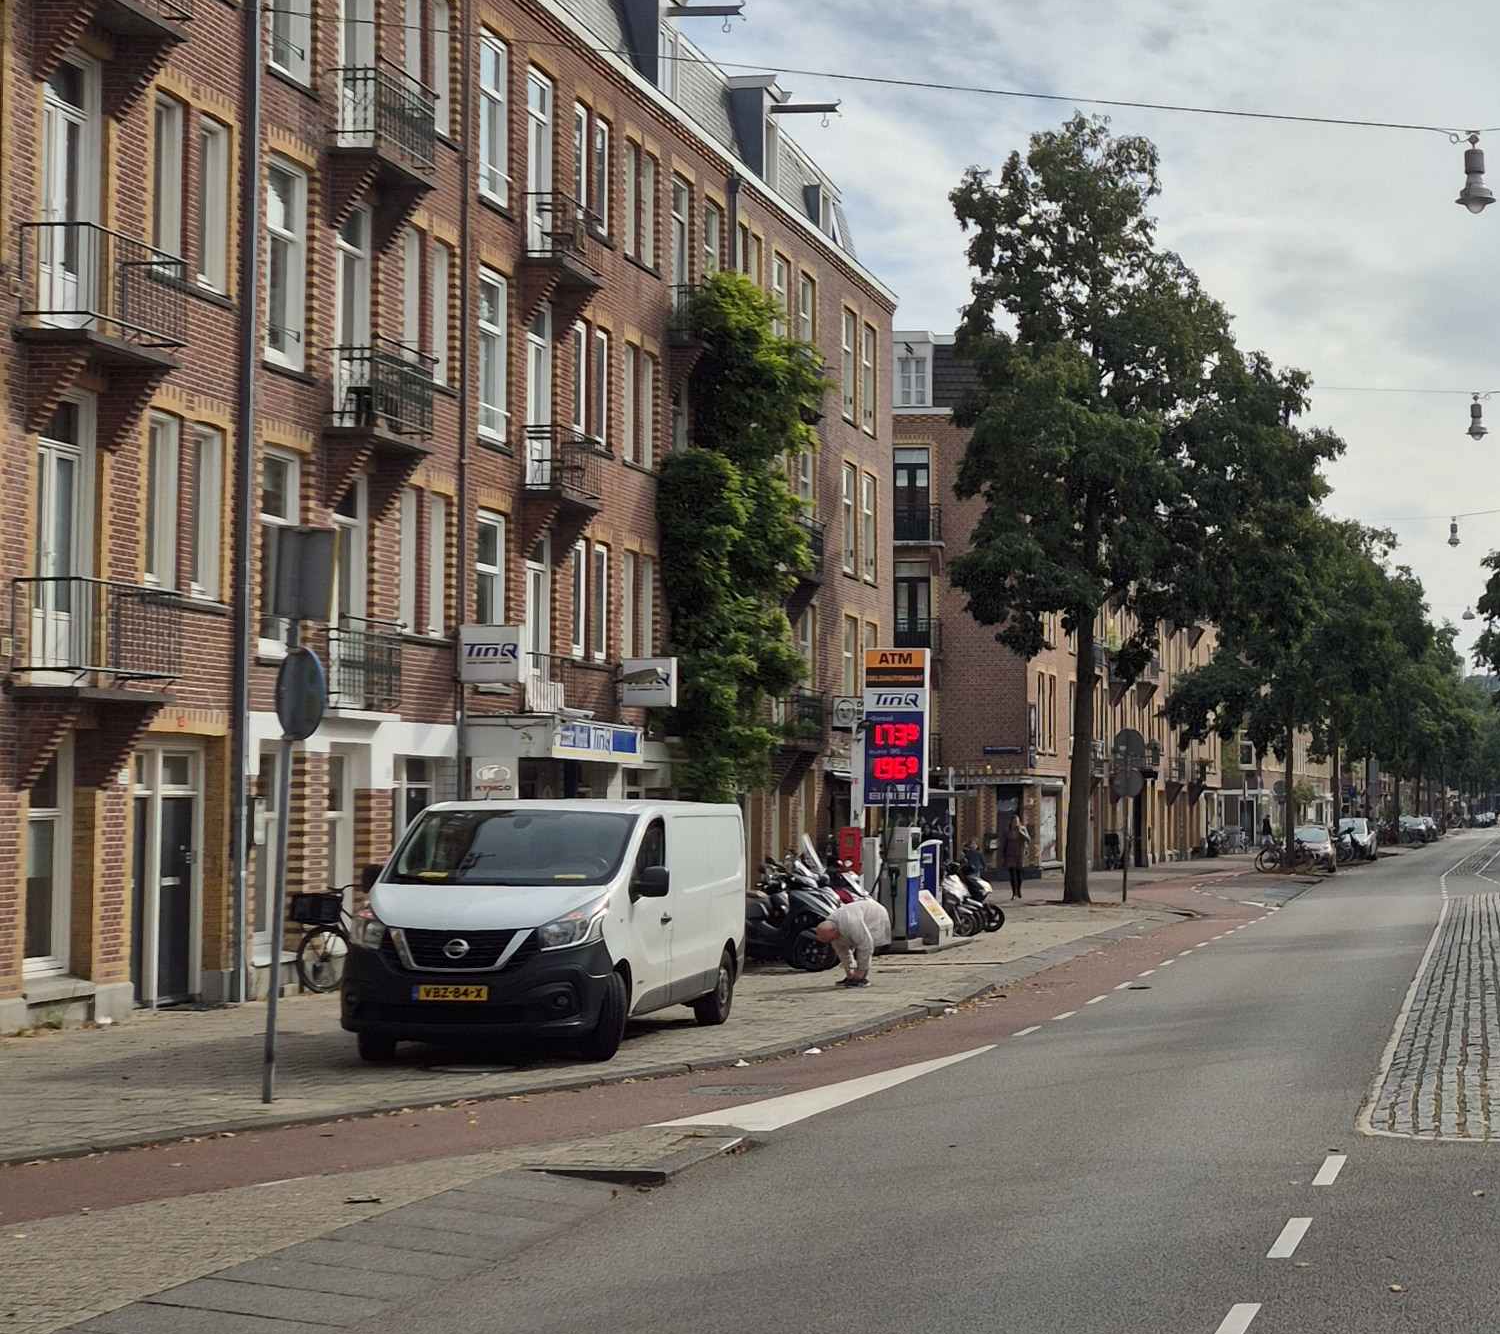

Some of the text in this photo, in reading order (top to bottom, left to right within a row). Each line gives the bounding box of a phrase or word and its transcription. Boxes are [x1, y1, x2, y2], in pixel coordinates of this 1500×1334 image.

[464, 642, 518, 660] TinQ
[878, 652, 912, 665] ATM
[872, 692, 919, 708] TinQ
[423, 987, 483, 998] VBZ-84-X
